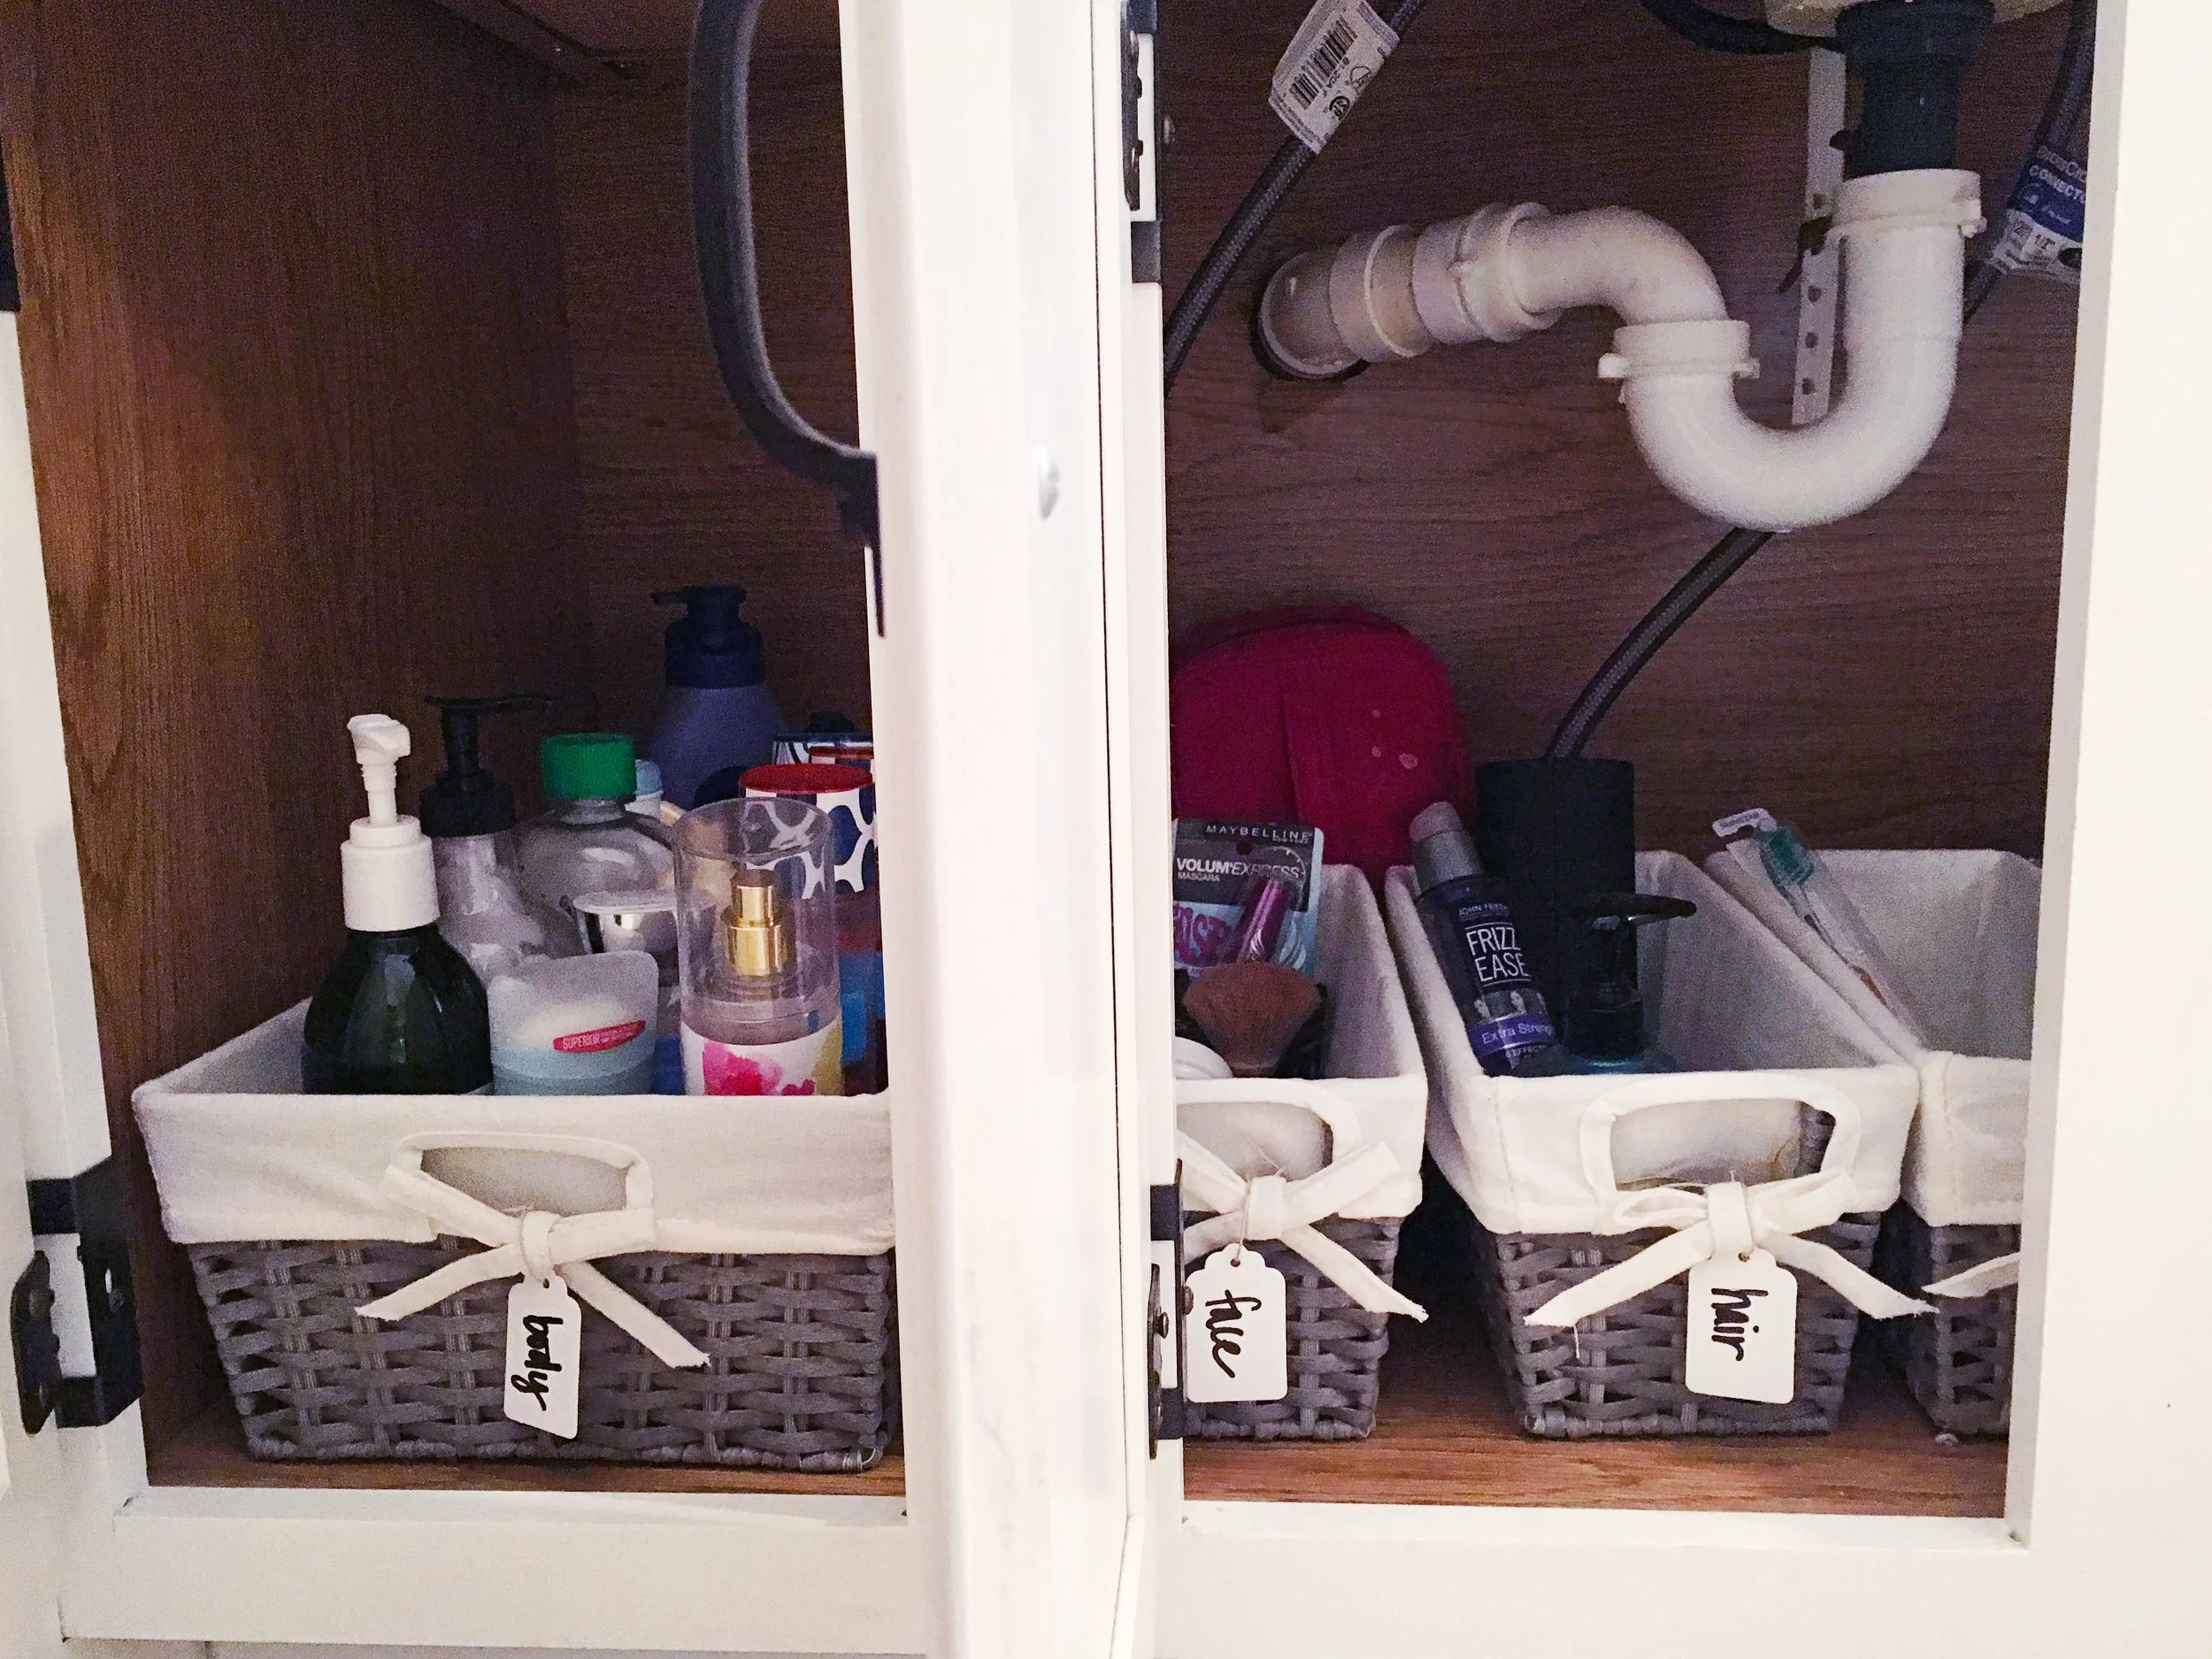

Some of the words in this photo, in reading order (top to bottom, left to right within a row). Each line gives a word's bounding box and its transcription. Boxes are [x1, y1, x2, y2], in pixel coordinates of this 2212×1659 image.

[1206, 826, 1311, 840] MAYBELLINE
[1178, 872, 1220, 882] MASCARA
[1466, 926, 1521, 956] FRIZZ
[1475, 953, 1529, 982] EASE
[562, 1032, 601, 1050] SUPERIOR
[1481, 1027, 1516, 1044] Extra
[1205, 1289, 1262, 1379] face
[1710, 1287, 1769, 1362] hair
[511, 1314, 564, 1411] body
